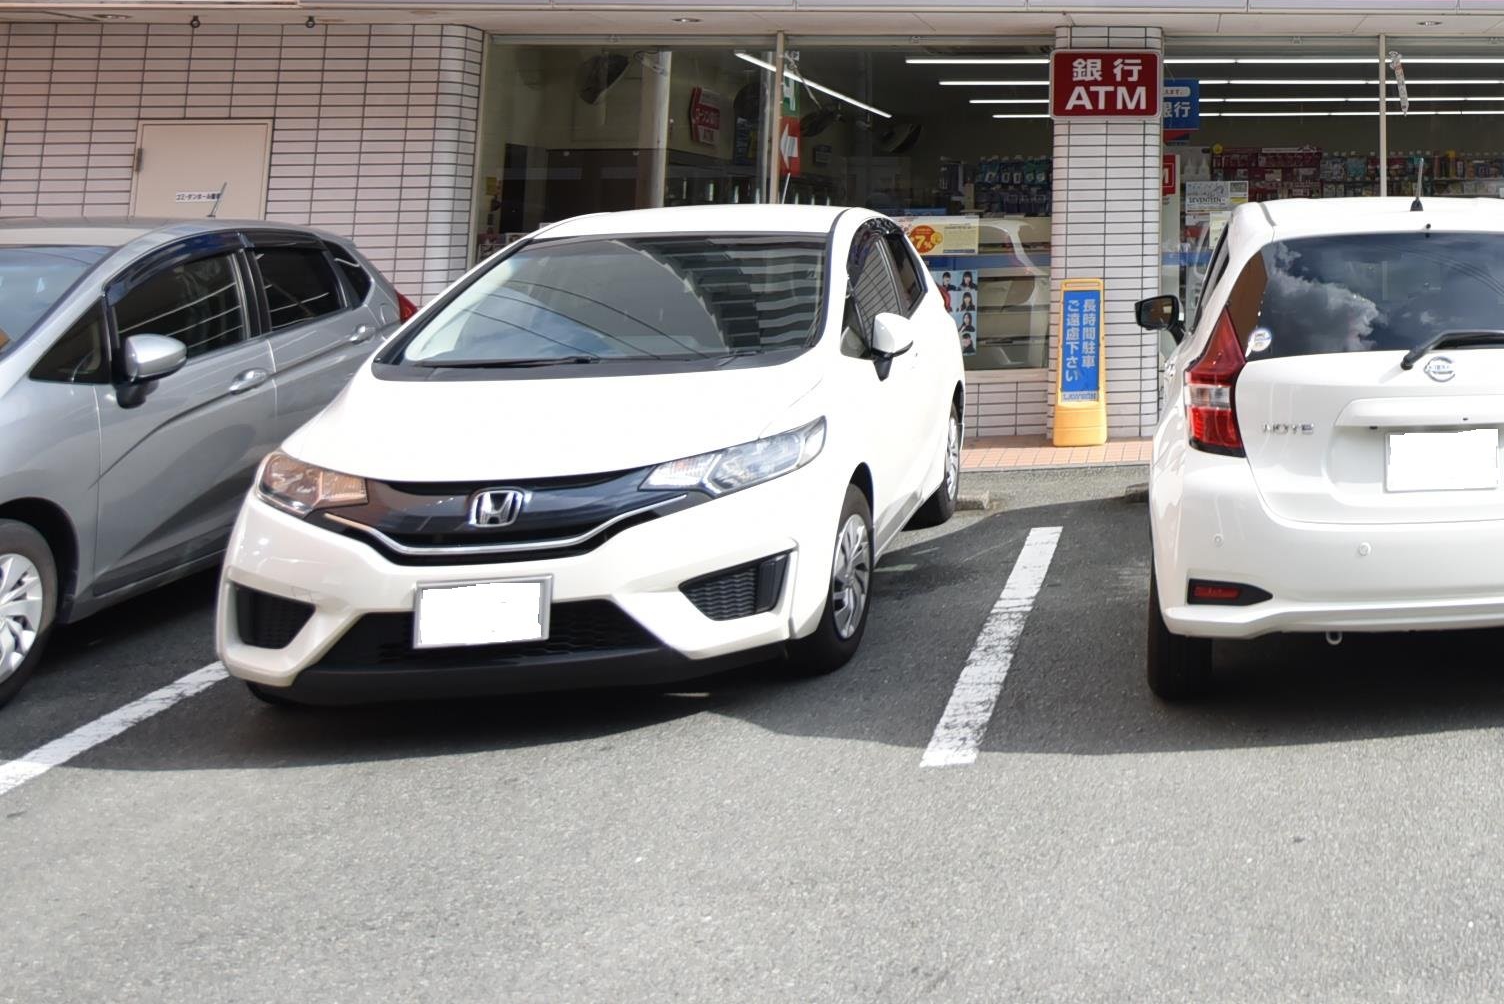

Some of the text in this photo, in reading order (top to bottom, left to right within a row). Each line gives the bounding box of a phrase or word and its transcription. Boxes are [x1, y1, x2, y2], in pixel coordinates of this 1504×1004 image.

[1072, 58, 1143, 82] 銀行
[1065, 86, 1148, 110] ATM
[1065, 299, 1081, 383] ご遠慮下さい
[1081, 298, 1096, 369] 長時間駐車
